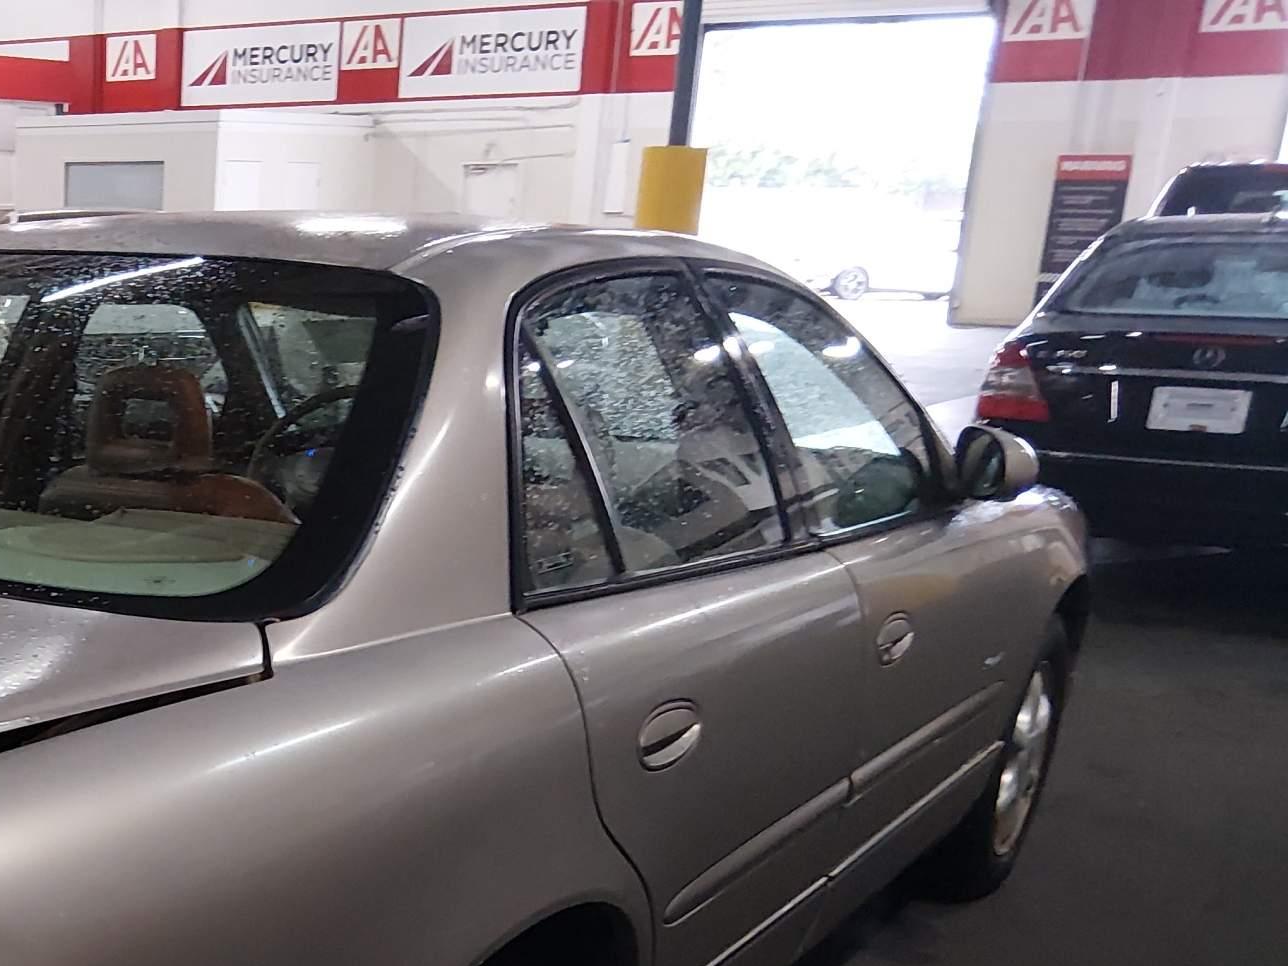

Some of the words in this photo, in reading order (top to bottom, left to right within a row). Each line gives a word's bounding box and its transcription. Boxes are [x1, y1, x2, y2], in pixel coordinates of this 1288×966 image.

[460, 28, 579, 55] MERCURY
[232, 42, 333, 67] MERCURY
[457, 53, 576, 75] INSURANCE
[232, 65, 332, 85] INSURANCE
